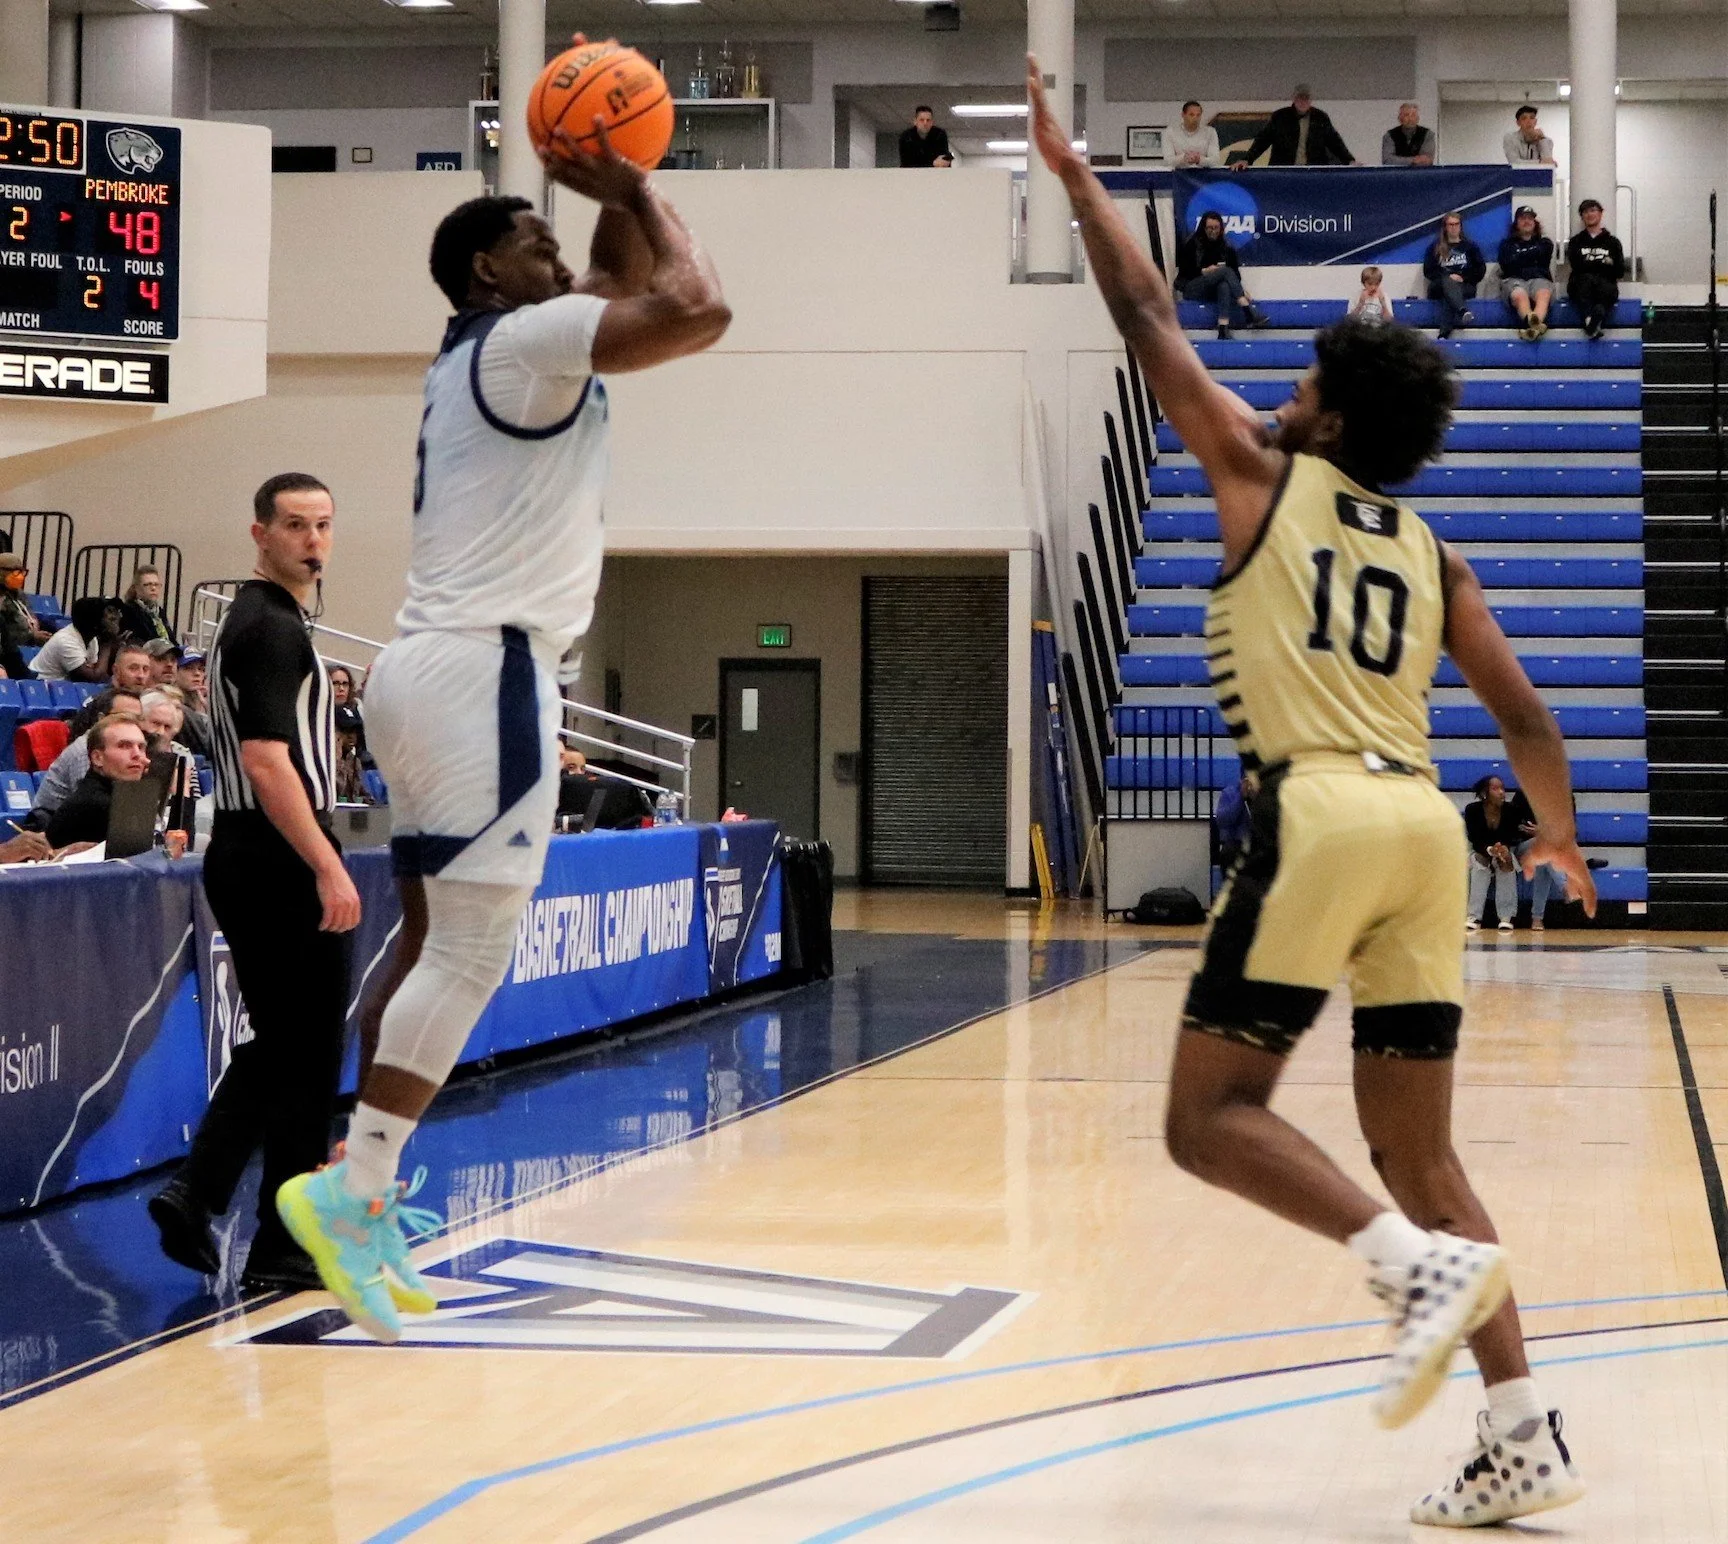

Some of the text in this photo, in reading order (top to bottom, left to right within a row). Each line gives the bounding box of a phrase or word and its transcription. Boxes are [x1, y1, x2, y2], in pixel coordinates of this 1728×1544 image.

[85, 178, 169, 205] PEMBROKE
[9, 206, 29, 240] 2
[108, 211, 161, 255] 48
[1264, 214, 1337, 233] Division
[1343, 214, 1352, 232] II
[0, 251, 63, 269] YER FOUL
[76, 256, 111, 272] T.O.L.
[124, 259, 164, 276] FOULS
[83, 275, 101, 309] 2
[139, 280, 160, 310] 4
[123, 319, 164, 336] SCORE
[1306, 548, 1409, 677] 10
[763, 631, 785, 645] EXIT
[512, 893, 602, 985] BASKETBALL
[0, 1024, 60, 1094] ision II
